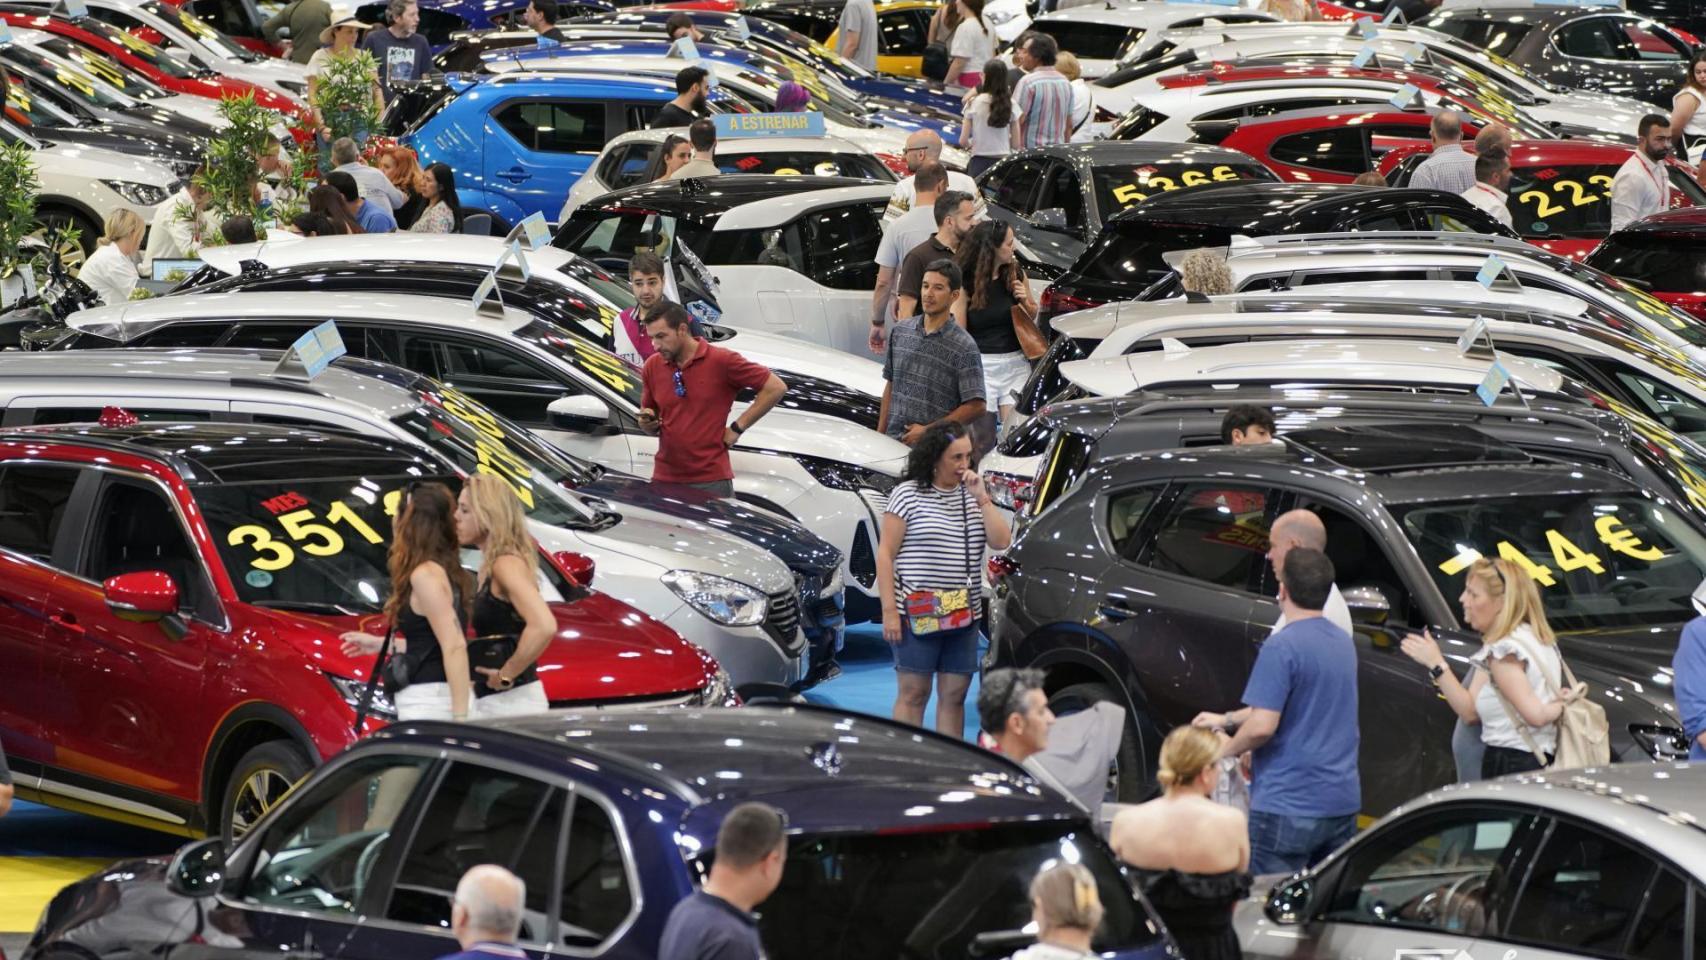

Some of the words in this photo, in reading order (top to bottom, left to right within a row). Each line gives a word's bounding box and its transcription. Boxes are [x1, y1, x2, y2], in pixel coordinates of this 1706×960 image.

[730, 117, 738, 130] A
[742, 115, 808, 130] ESTRENAR
[261, 491, 310, 515] MES
